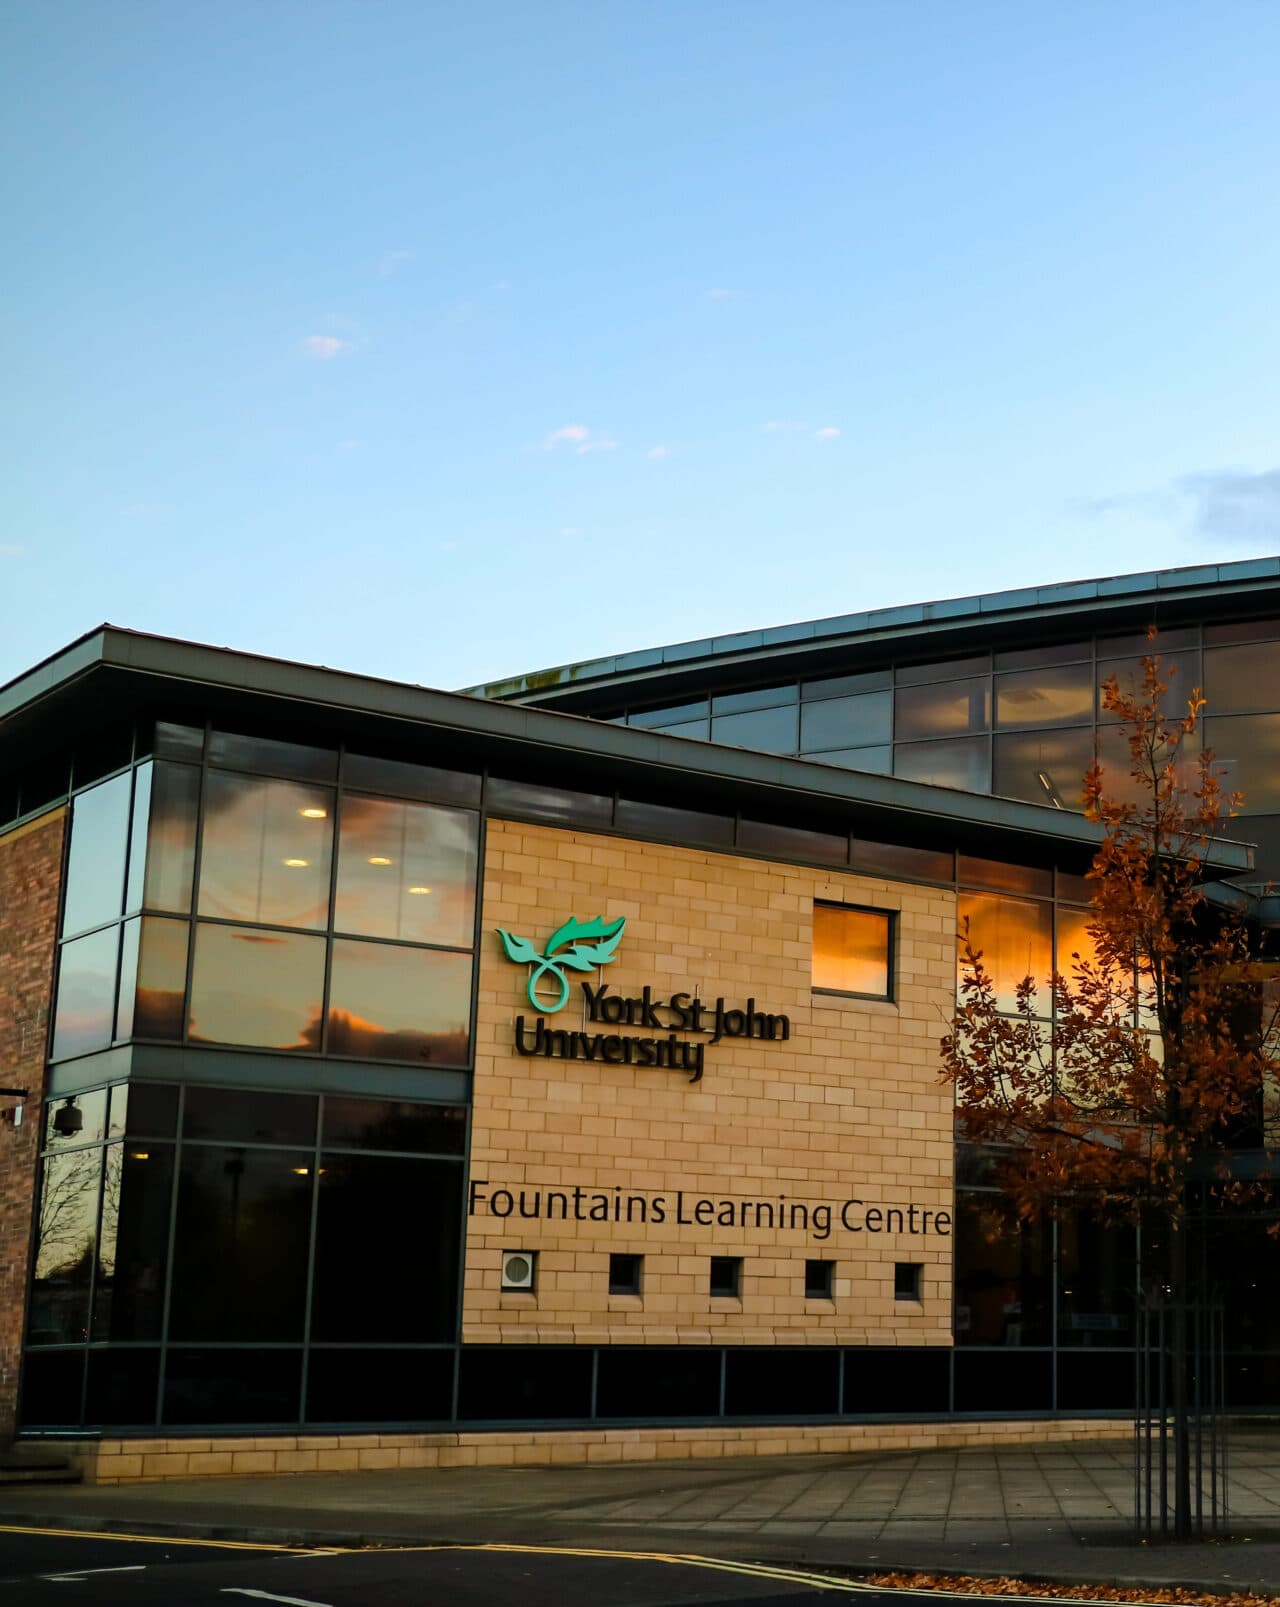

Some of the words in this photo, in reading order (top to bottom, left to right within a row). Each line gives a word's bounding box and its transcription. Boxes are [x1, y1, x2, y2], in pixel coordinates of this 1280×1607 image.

[581, 982, 663, 1029] York
[669, 992, 707, 1033] St
[708, 998, 790, 1044] John
[515, 1015, 704, 1083] University
[468, 1180, 666, 1224] Fountains
[676, 1191, 832, 1240] Learning
[841, 1199, 951, 1236] Centre
